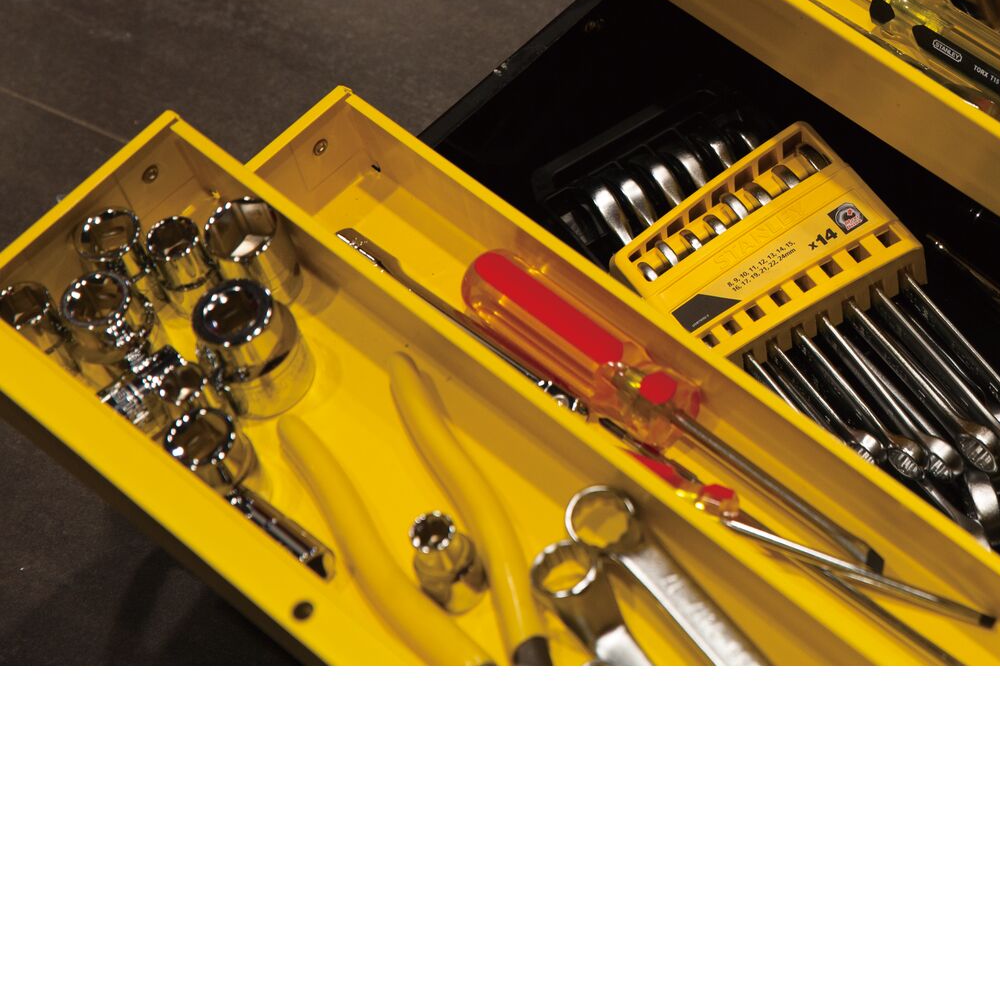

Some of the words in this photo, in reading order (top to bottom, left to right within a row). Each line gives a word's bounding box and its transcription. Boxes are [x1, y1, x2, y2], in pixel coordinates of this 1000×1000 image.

[934, 41, 960, 60] STANLEY
[973, 64, 989, 78] TORX
[990, 75, 1000, 85] T15
[714, 198, 807, 271] STANLEY
[807, 227, 839, 251] x14
[732, 284, 742, 292] 16,
[741, 278, 752, 286] 17,
[778, 248, 796, 261] 24mm
